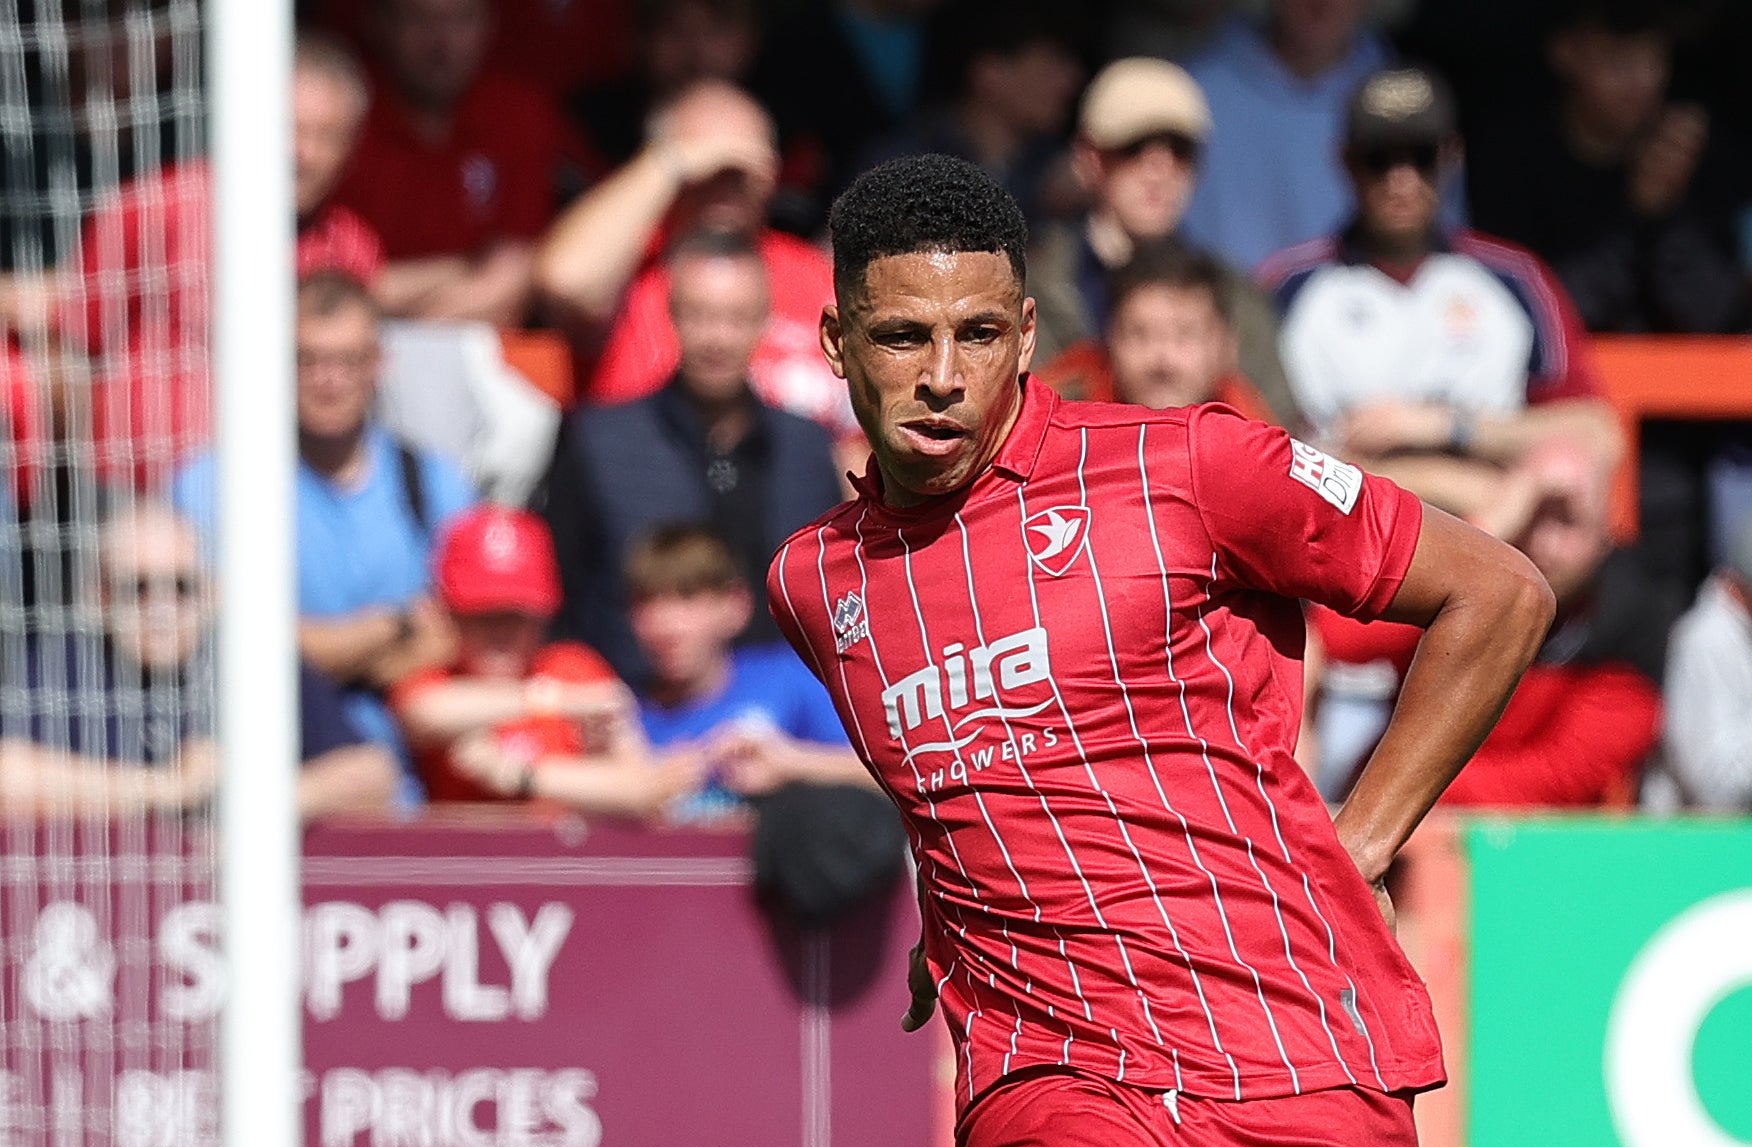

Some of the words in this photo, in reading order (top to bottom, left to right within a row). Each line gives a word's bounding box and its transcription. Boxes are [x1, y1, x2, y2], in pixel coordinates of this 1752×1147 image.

[881, 626, 1050, 740] mira
[916, 727, 1059, 794] SHOWERS
[157, 899, 575, 1023] SPPLY
